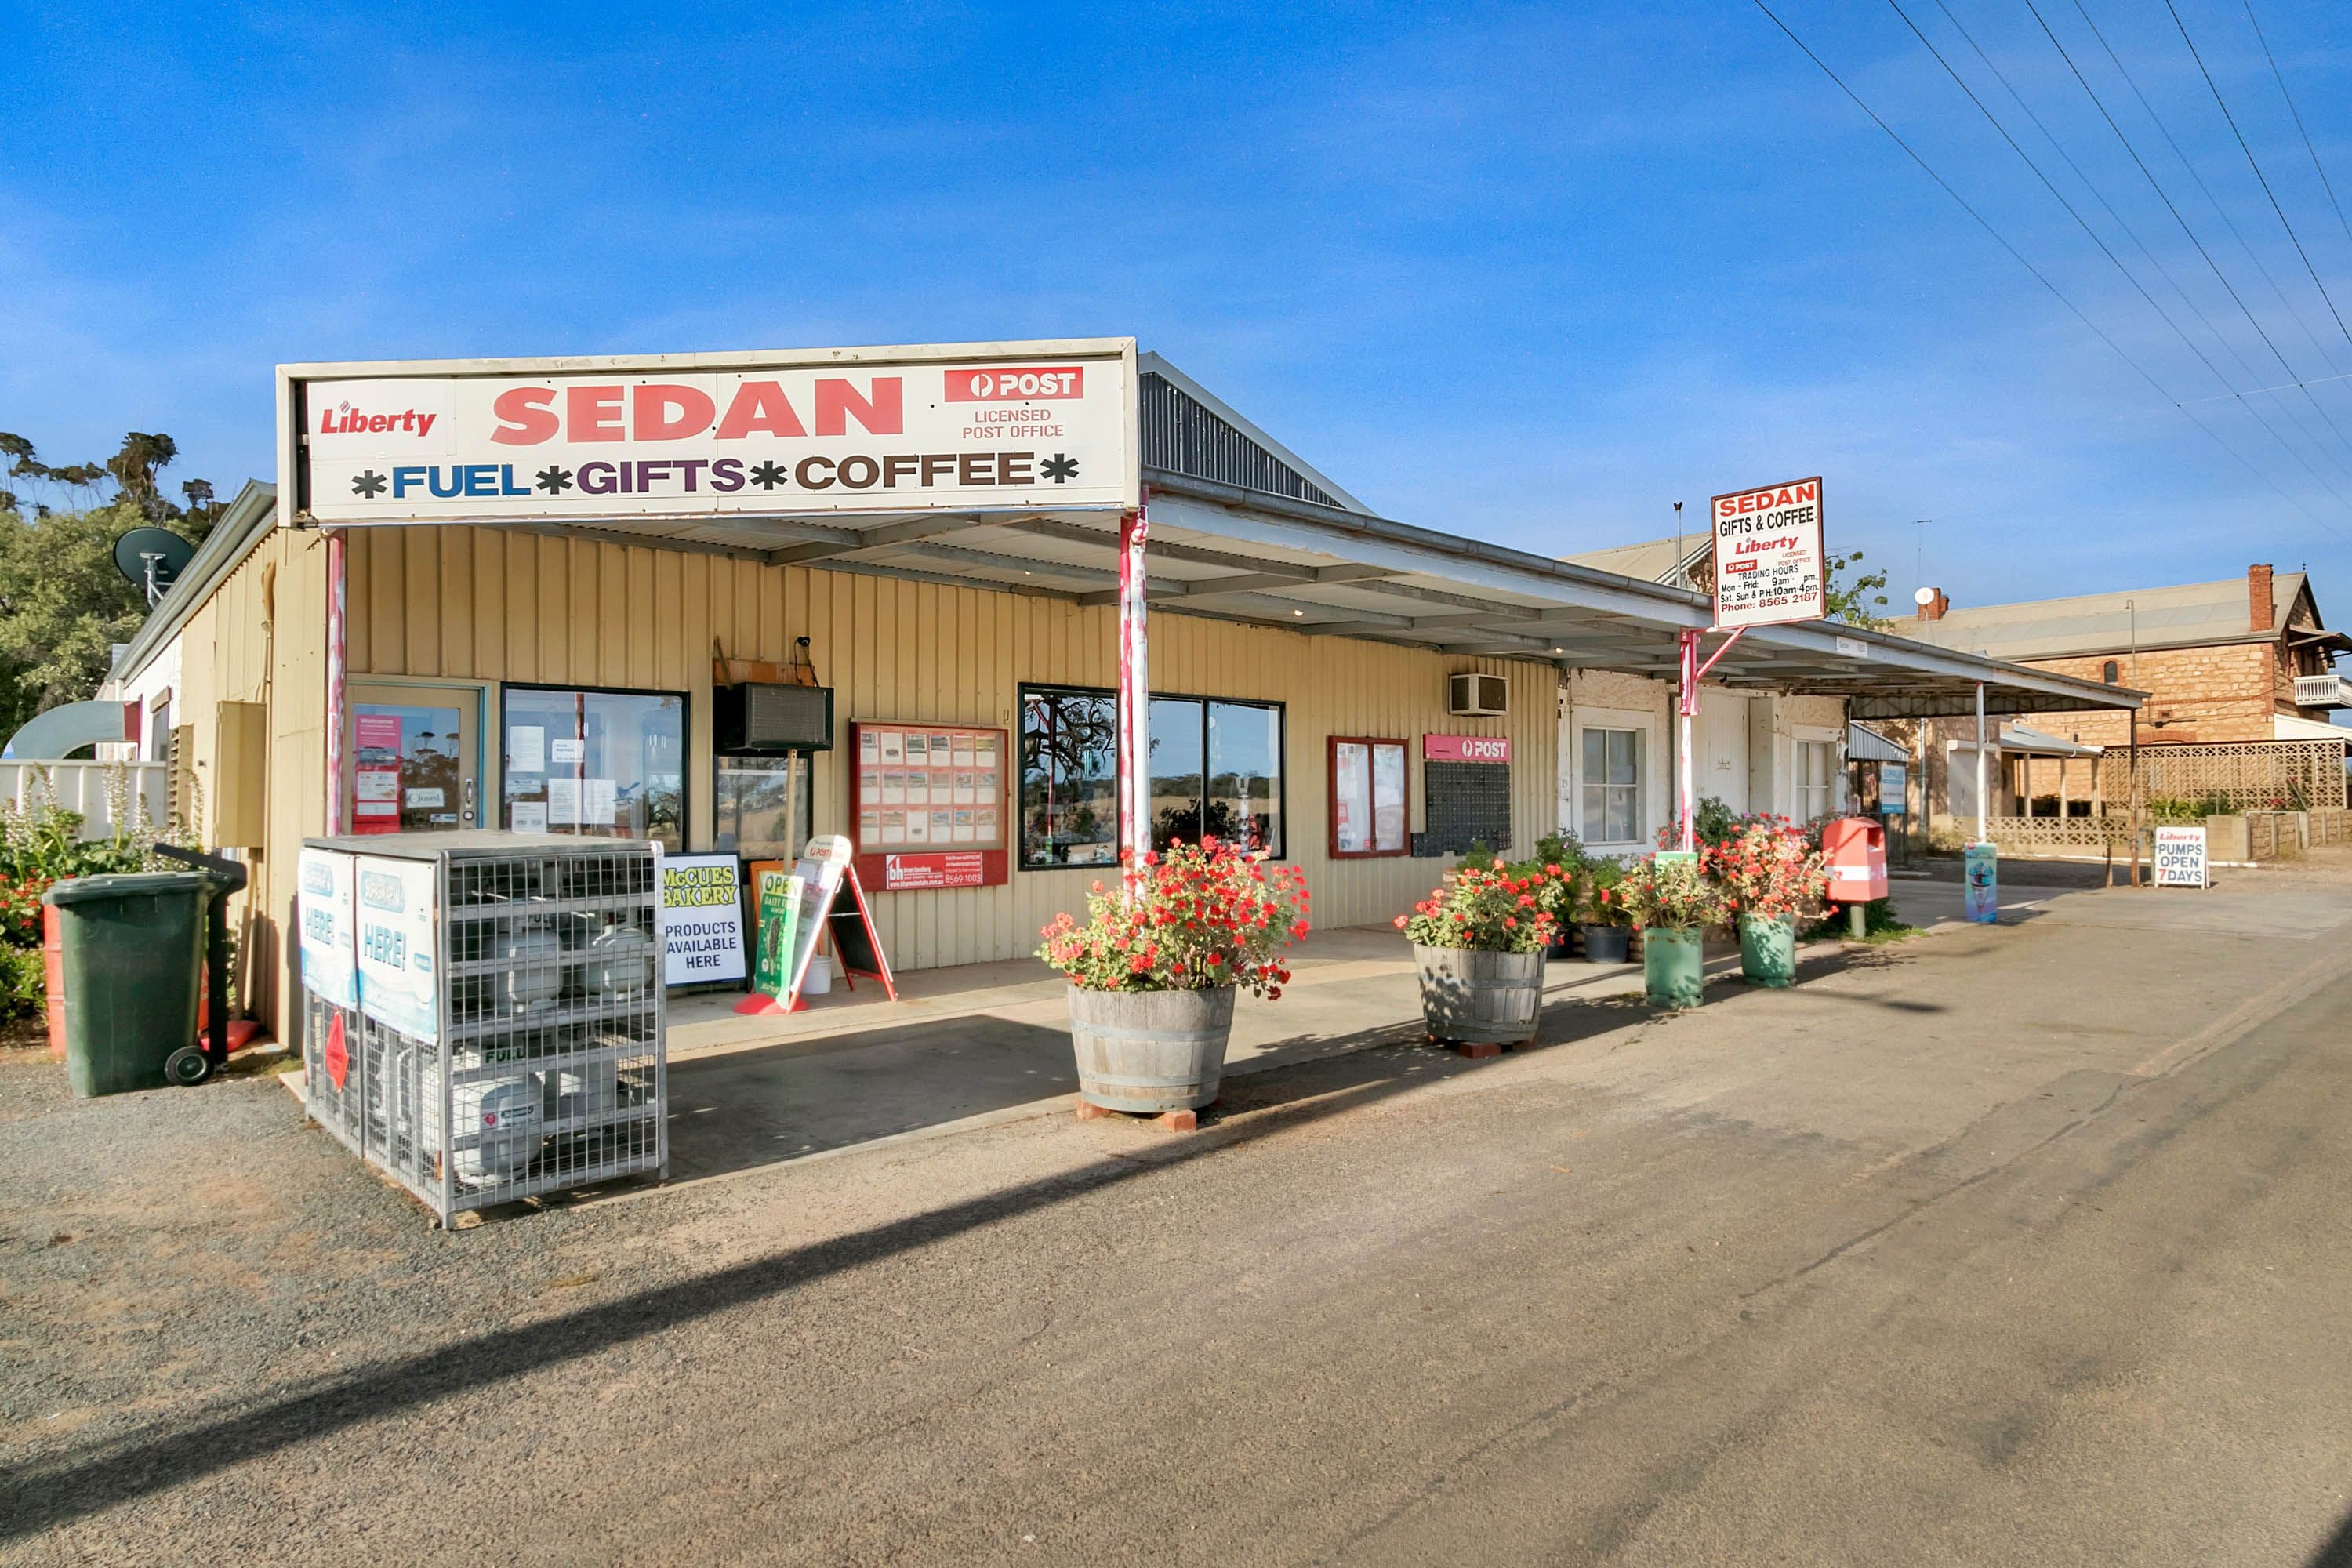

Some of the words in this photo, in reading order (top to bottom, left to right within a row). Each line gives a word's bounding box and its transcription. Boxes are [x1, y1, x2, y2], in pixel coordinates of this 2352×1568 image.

[1000, 372, 1076, 397] POST
[321, 401, 437, 437] Liberty
[490, 376, 903, 445] SEDAN
[975, 408, 1051, 423] LICENSED
[963, 426, 1004, 439] POST
[1010, 424, 1064, 437] OFFICE
[393, 464, 531, 499] FUEL
[577, 459, 744, 494] GIFTS
[795, 452, 1035, 490] COFFEE
[1719, 483, 1815, 517] SEDAN
[1719, 517, 1751, 536] GIFTS
[1756, 514, 1764, 531] &
[1767, 506, 1814, 529] COFFEE
[1735, 536, 1799, 555] Liberty
[1738, 568, 1770, 581] TRADING
[1773, 564, 1798, 575] HOURS
[1721, 584, 1735, 593] Mon
[1736, 593, 1749, 601] Sun
[1752, 590, 1756, 599] &
[1721, 602, 1755, 612] Phone:
[1759, 596, 1788, 608] 8565
[1792, 592, 1817, 603] 2187
[1475, 741, 1506, 758] POST
[2160, 832, 2201, 841] Liberty
[2158, 844, 2203, 855] PUMPS
[2161, 856, 2199, 868] OPEN
[664, 866, 735, 887] McCUES
[945, 874, 963, 884] 8569
[964, 873, 981, 883] 1003
[2158, 869, 2166, 880] 7
[2168, 870, 2202, 882] DAYS
[765, 874, 799, 896] OPEN
[664, 885, 738, 908] BAKERY
[666, 921, 735, 938] PRODUCTS
[364, 922, 406, 972] HERE!
[666, 937, 737, 954] AVAILABLE
[686, 954, 721, 969] HERE
[485, 1047, 525, 1063] FULL
